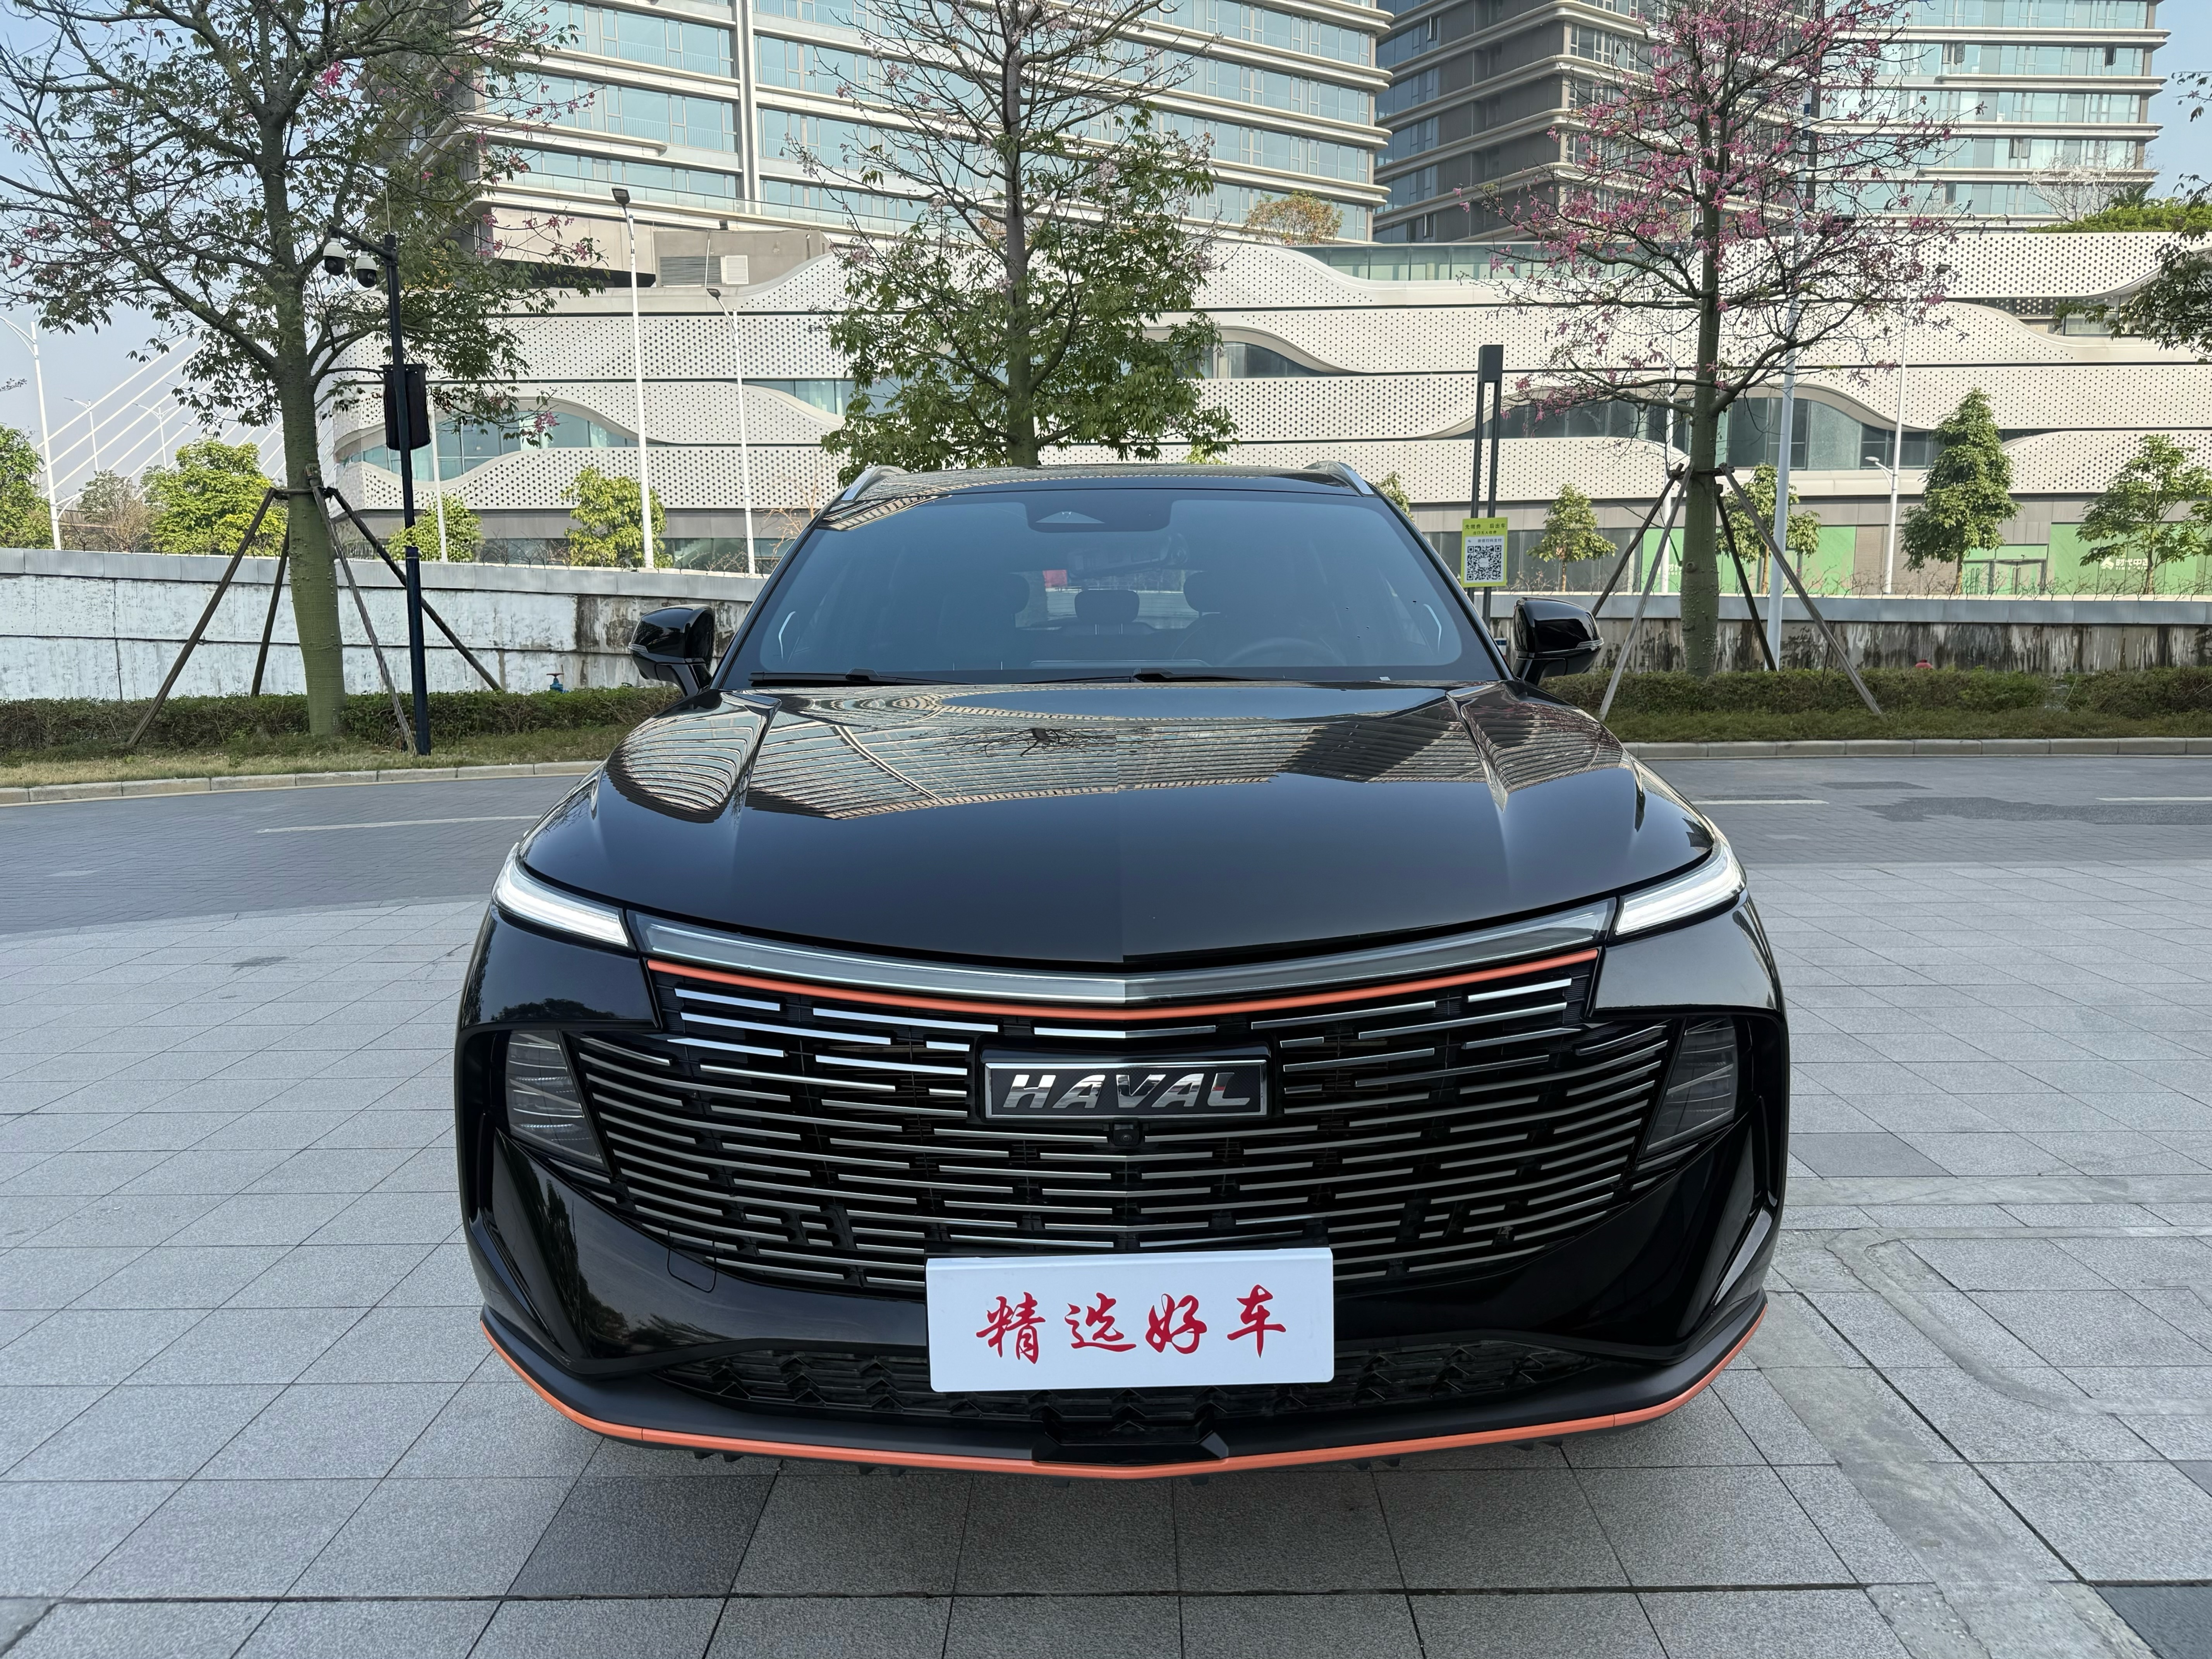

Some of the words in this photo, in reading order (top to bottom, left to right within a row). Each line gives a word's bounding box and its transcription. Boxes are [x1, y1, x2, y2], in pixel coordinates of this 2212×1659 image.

[1003, 1072, 1250, 1108] HAVAL
[976, 1284, 1286, 1364] 精选好车
